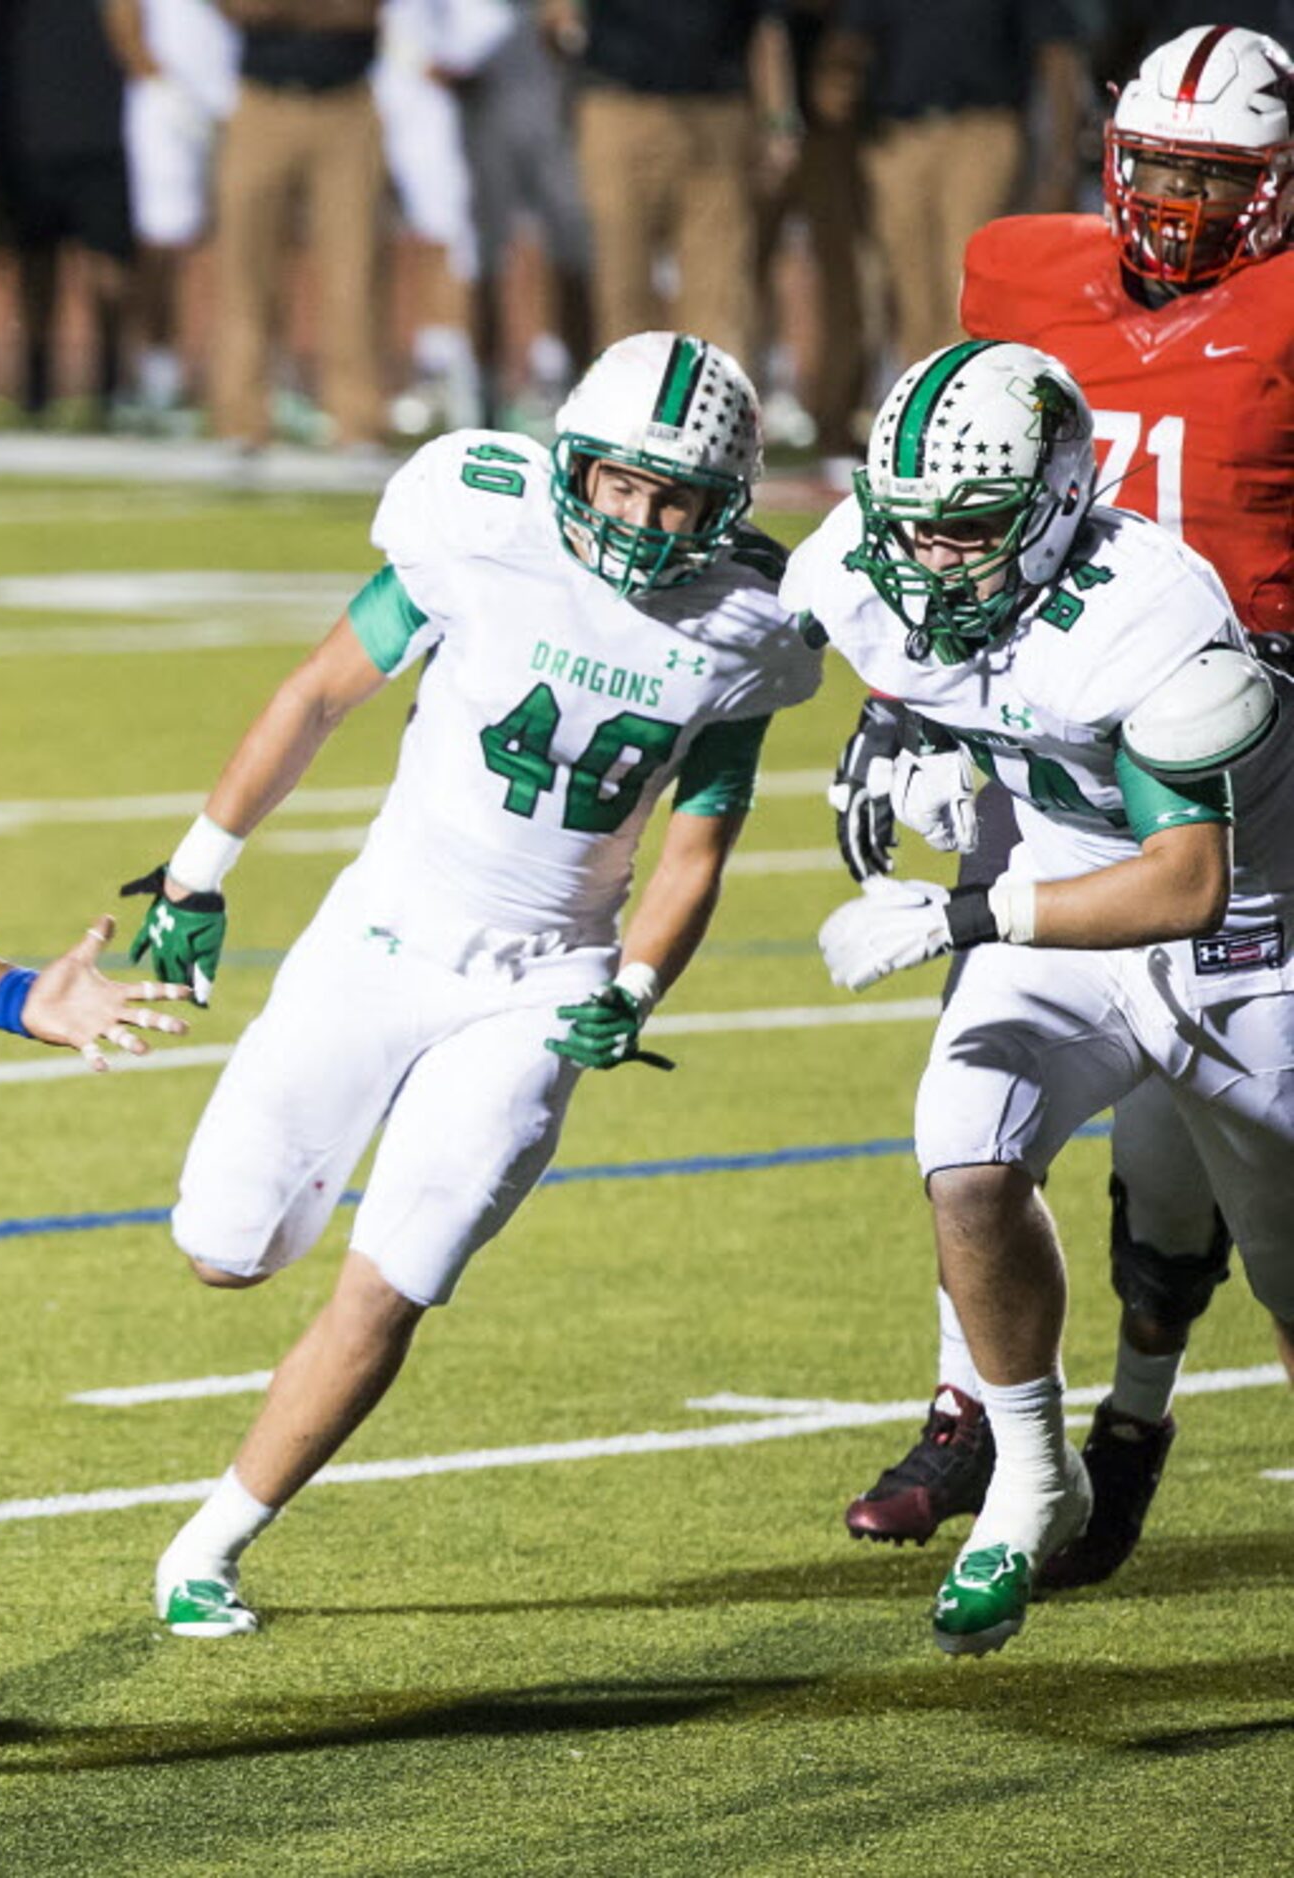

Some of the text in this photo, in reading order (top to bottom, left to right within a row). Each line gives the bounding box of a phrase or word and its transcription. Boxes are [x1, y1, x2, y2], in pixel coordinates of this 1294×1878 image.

[461, 444, 529, 498] 40
[1092, 409, 1185, 540] 71
[1036, 563, 1116, 632] 84
[531, 639, 663, 708] DRAGONS
[480, 681, 684, 834] 40
